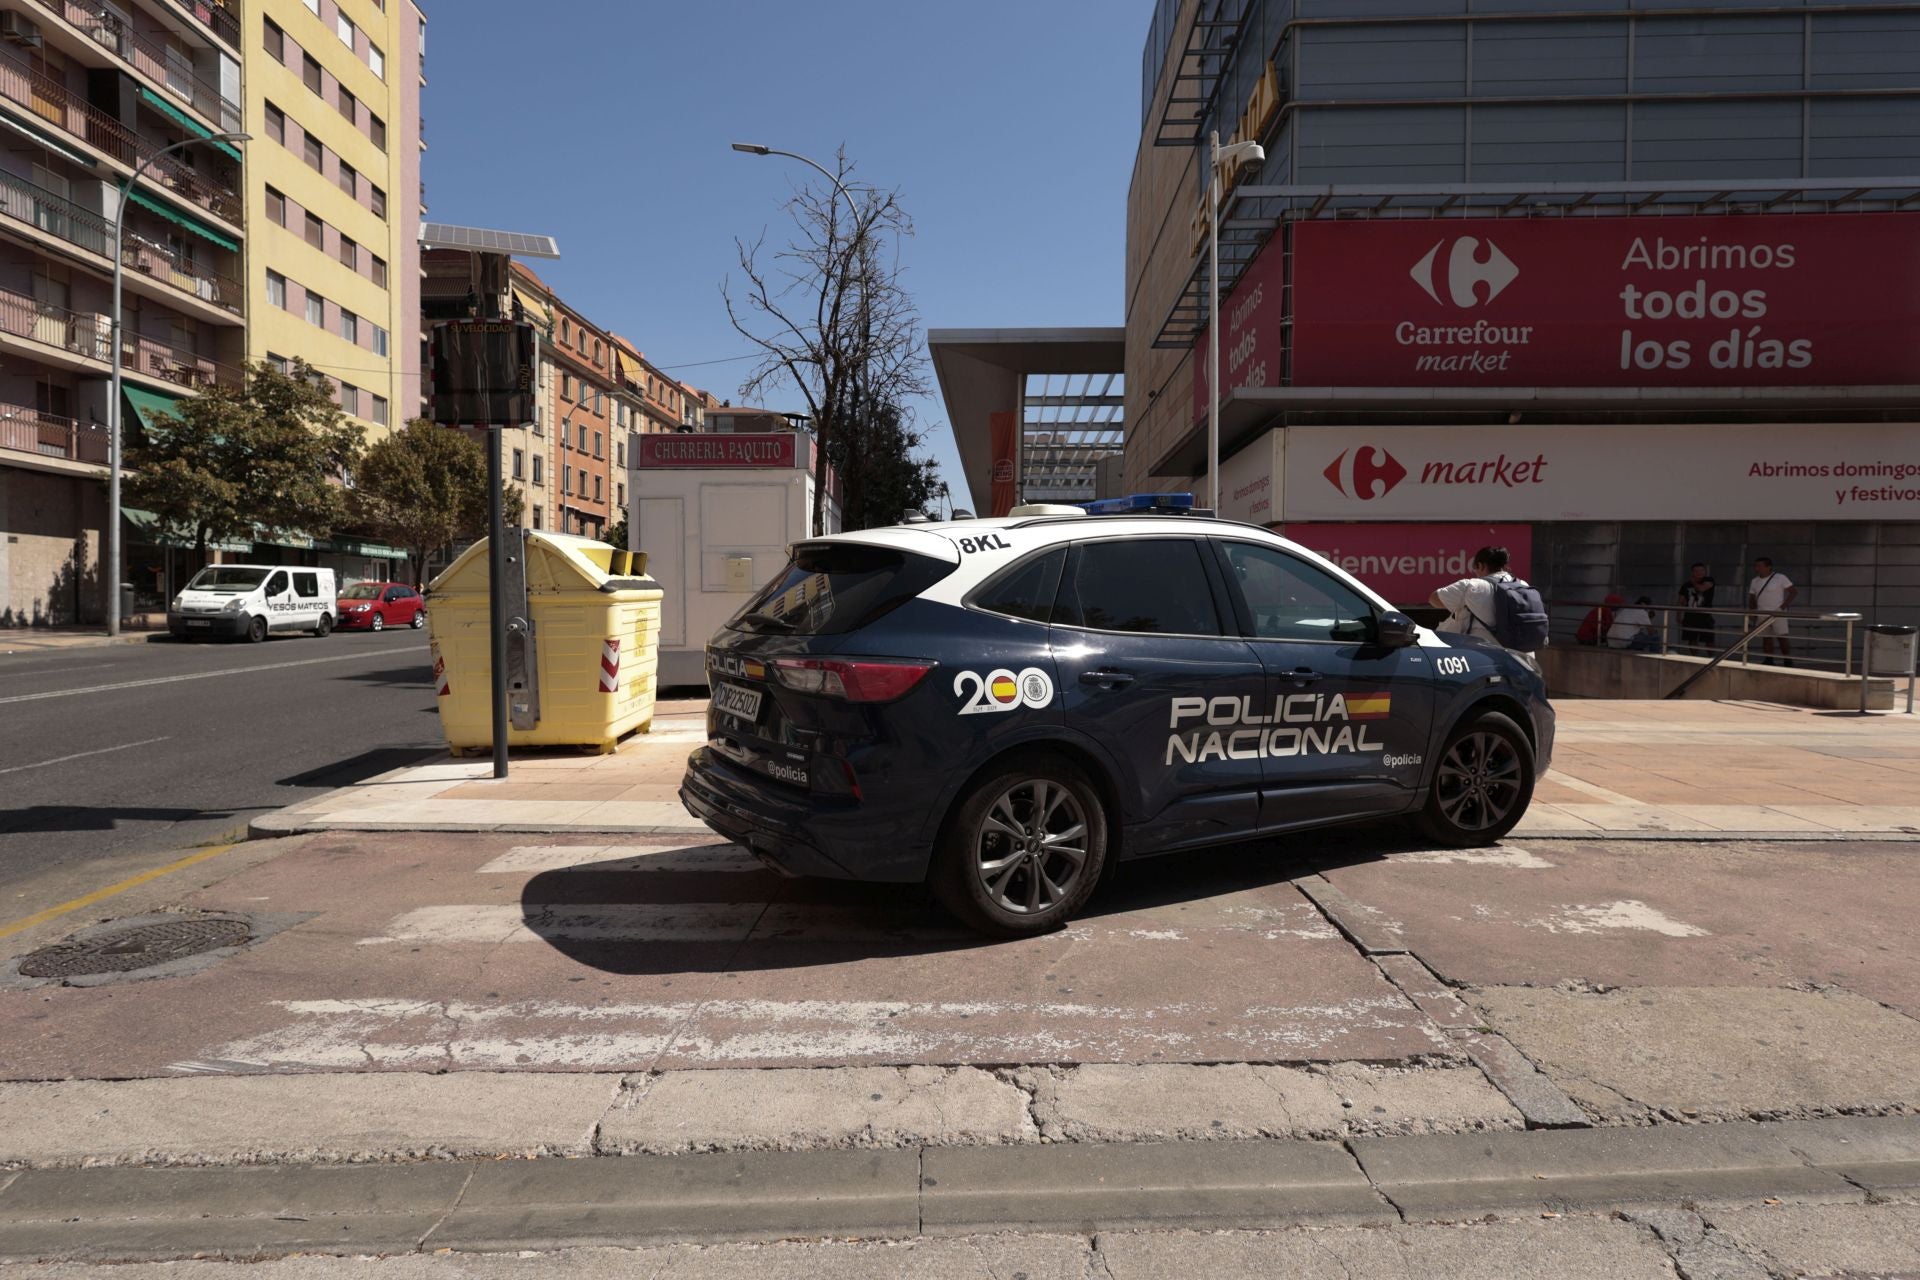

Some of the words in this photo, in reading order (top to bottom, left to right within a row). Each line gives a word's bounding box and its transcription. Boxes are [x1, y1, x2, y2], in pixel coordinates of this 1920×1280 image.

[1622, 236, 1796, 271] Abrimos
[1229, 282, 1263, 336] Abrimos
[1619, 279, 1767, 319] todos
[463, 324, 511, 333] VELOCIDAD
[1395, 319, 1533, 345] Carrefour
[1229, 327, 1257, 374] todos
[1620, 329, 1692, 370] los
[1708, 325, 1813, 369] días
[1415, 350, 1511, 373] market
[654, 441, 725, 459] CHURRERIA
[728, 441, 782, 463] PAQUITO
[1420, 454, 1548, 488] market
[1748, 461, 1830, 477] Abrimos
[1835, 489, 1846, 504] y
[959, 533, 1012, 554] 8KL
[268, 602, 296, 611] YESOS
[297, 602, 329, 610] MATEOS
[953, 667, 1054, 716] 200
[1165, 724, 1384, 766] NACIONAL
[767, 759, 808, 784] @policia
[1382, 752, 1422, 768] @policia
